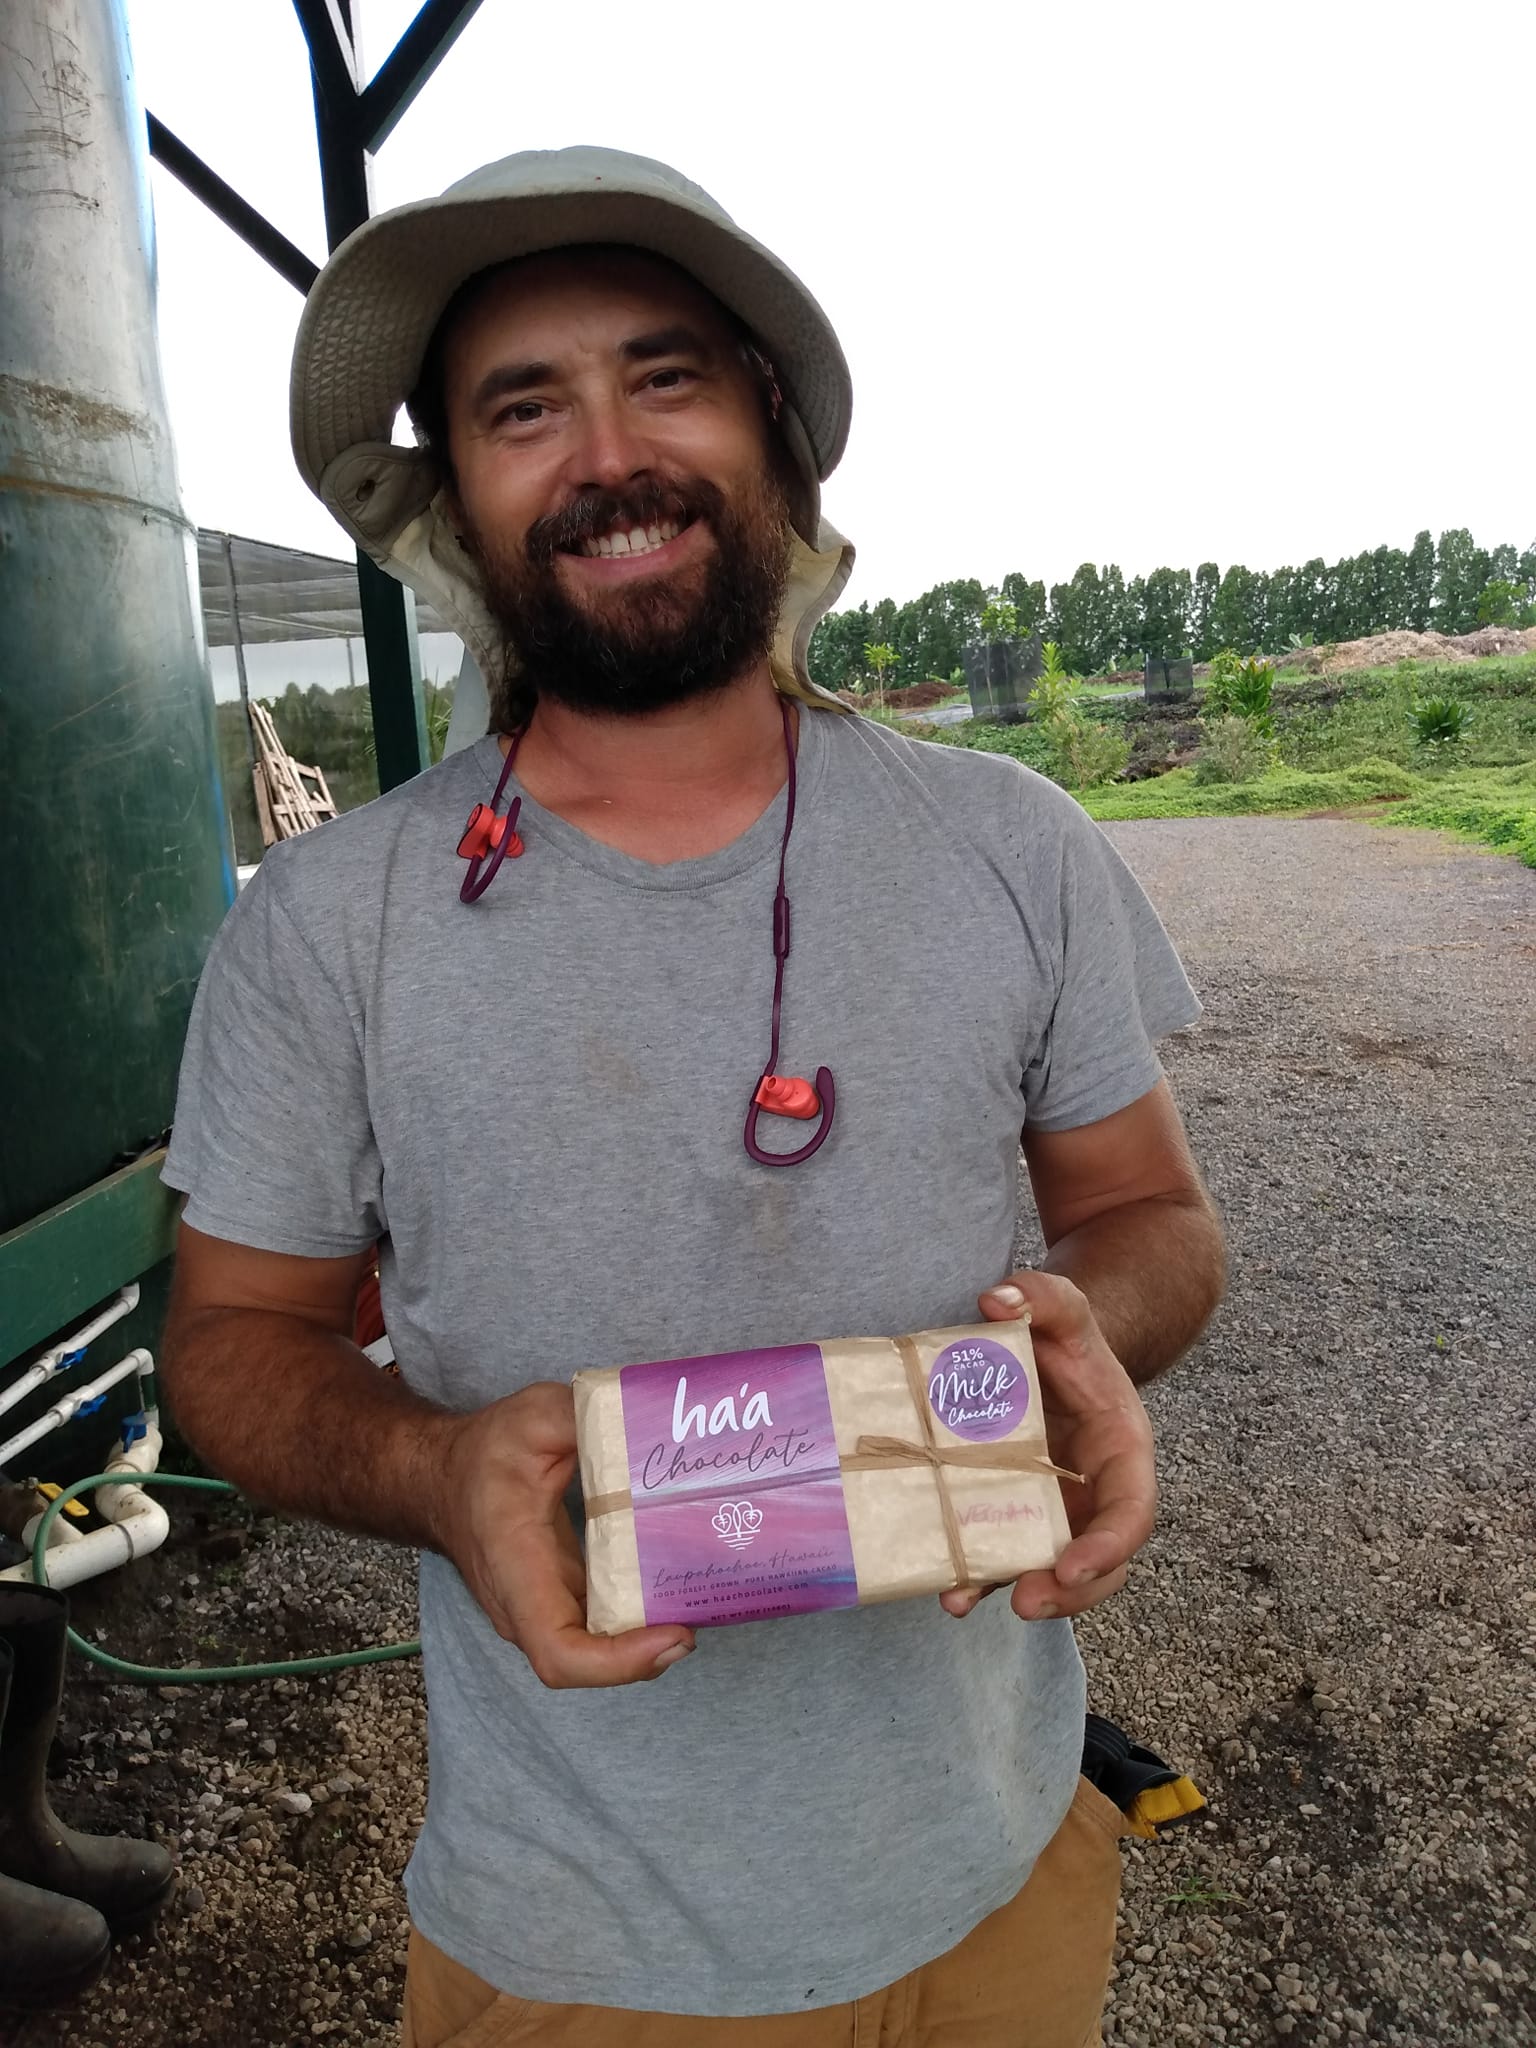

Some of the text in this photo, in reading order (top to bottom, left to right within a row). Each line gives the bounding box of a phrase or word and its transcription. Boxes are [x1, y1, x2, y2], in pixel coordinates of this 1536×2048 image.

[951, 1347, 984, 1363] 51%
[954, 1360, 985, 1370] CACAO
[930, 1364, 1018, 1412] Milk
[948, 1401, 1014, 1427] Chocolate
[642, 1428, 815, 1490] Chocolate
[653, 1590, 675, 1599] FOOD
[678, 1585, 706, 1595] FOREST
[710, 1580, 739, 1590] GROWN
[812, 1564, 837, 1574] CACAO
